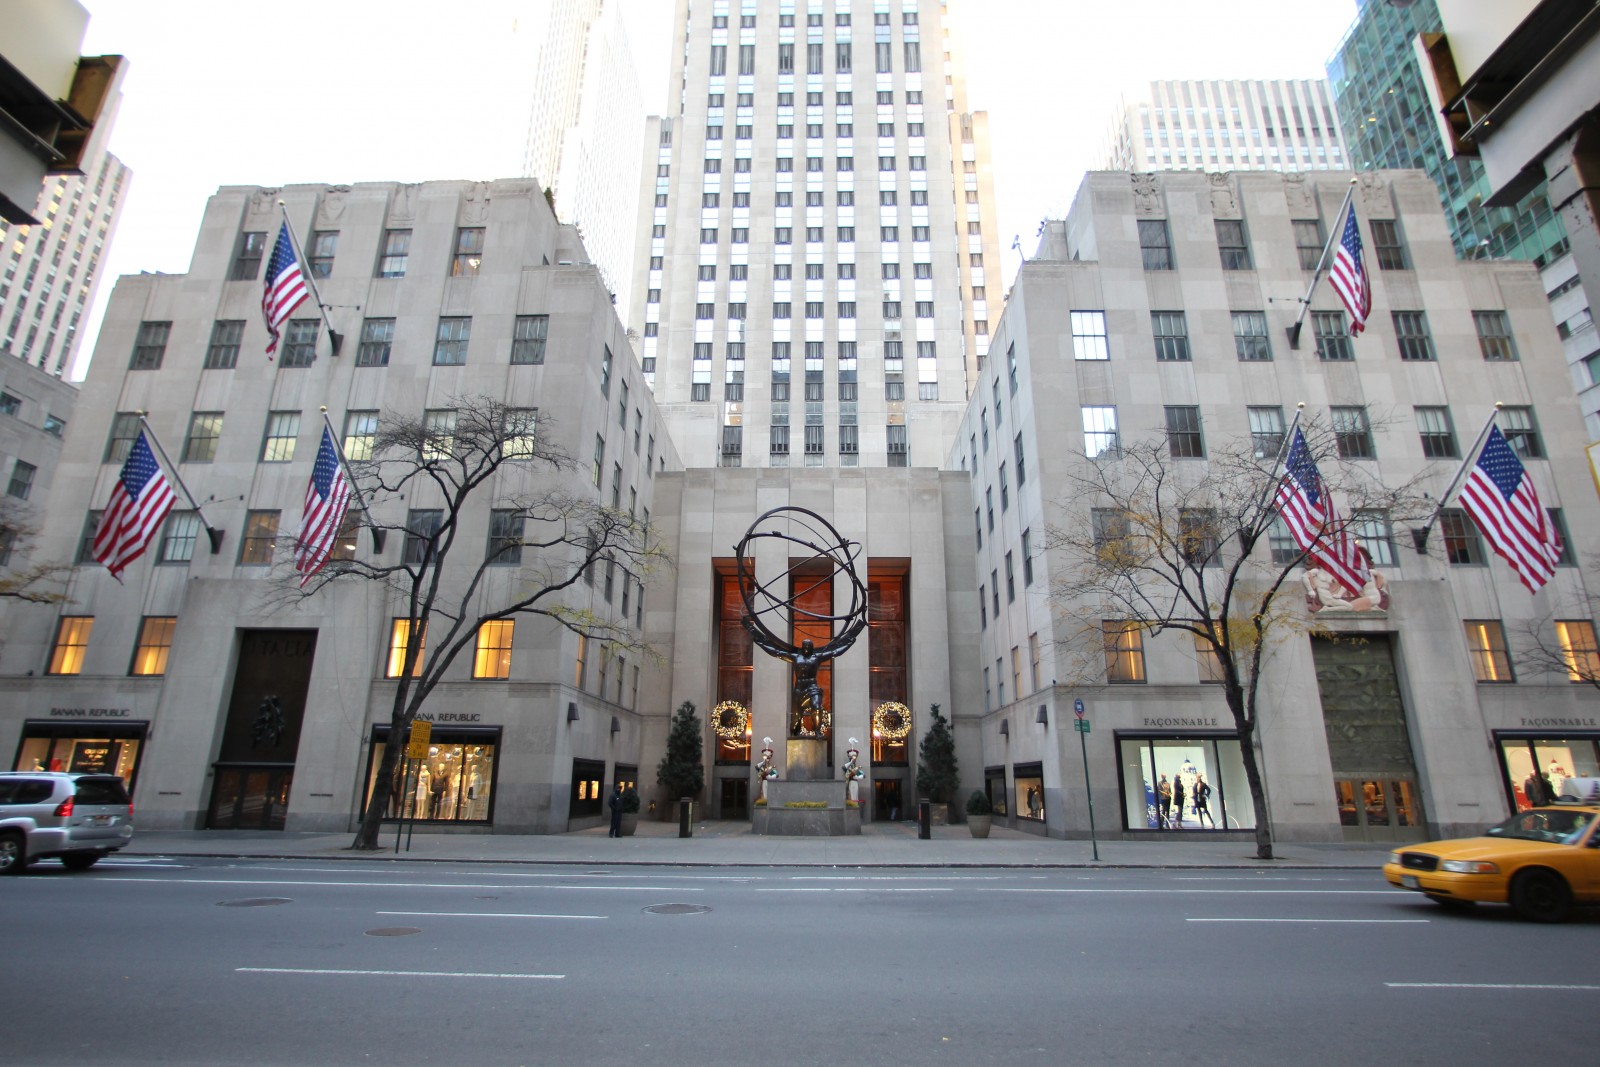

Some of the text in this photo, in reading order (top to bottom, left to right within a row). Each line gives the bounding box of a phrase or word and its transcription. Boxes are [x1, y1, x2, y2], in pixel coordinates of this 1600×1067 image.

[251, 639, 313, 656] ITALIA
[50, 708, 130, 717] BANANA REPUBLIC
[438, 713, 481, 722] REPUBLIC
[1143, 718, 1218, 727] FAÇONNABLE
[1520, 718, 1597, 728] FAÇONNABLE
